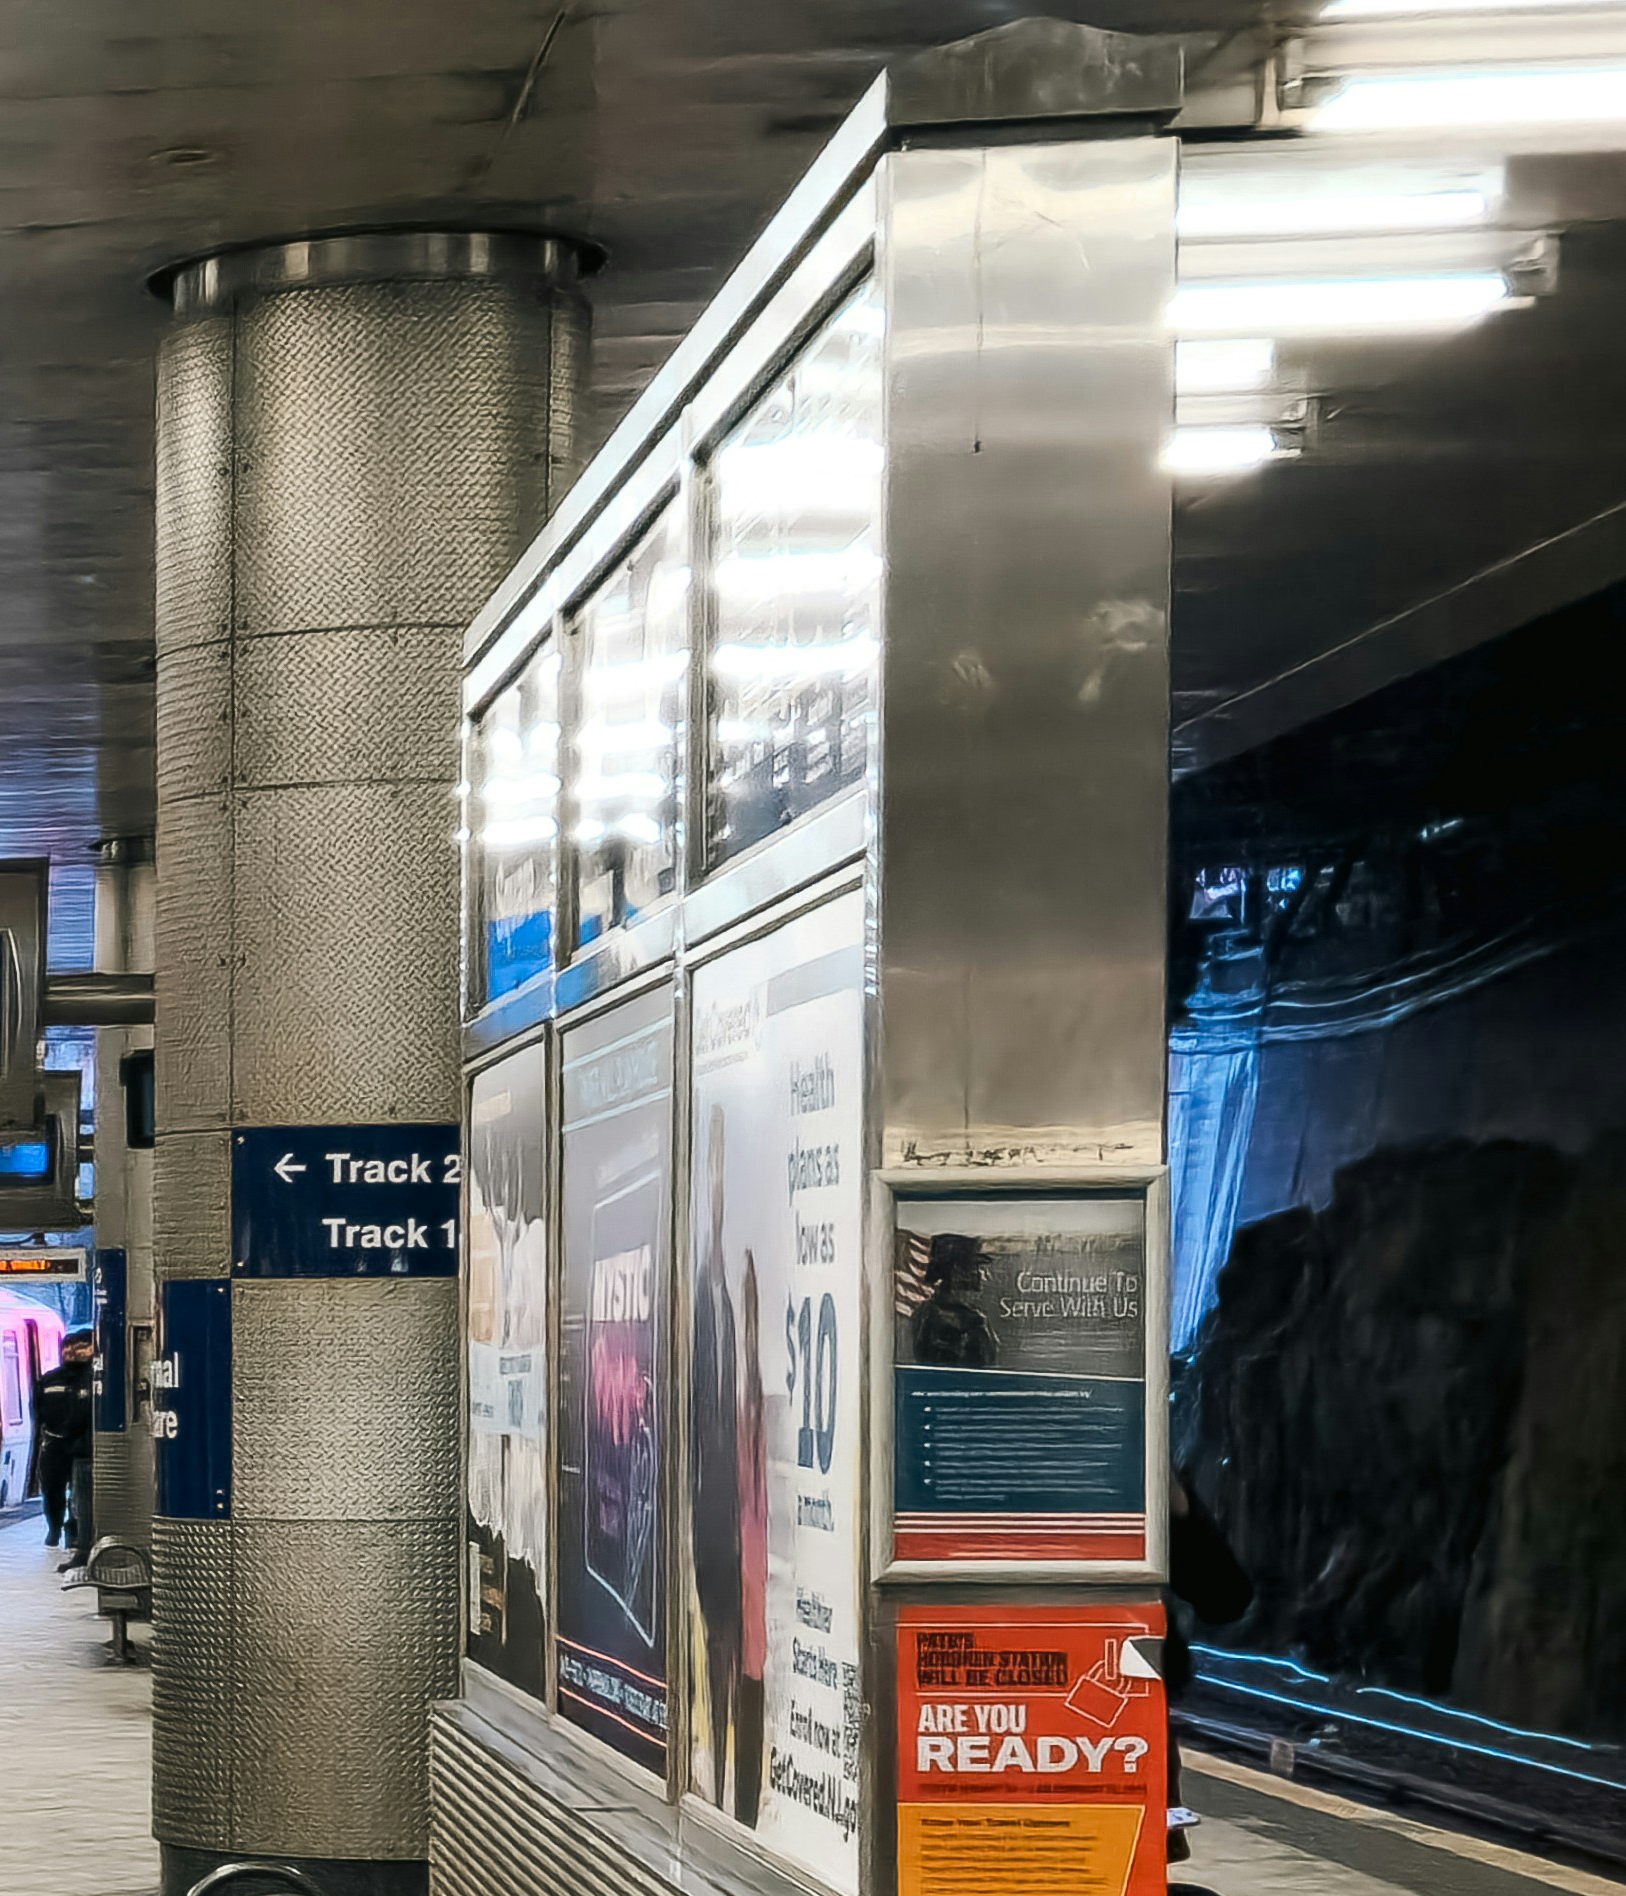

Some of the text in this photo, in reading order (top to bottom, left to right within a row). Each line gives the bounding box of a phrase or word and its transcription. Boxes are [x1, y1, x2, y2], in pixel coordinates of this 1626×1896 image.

[790, 1052, 835, 1116] Health
[325, 1152, 462, 1184] Track 2
[321, 1217, 456, 1249] Track 1
[1017, 1271, 1138, 1294] Continue To
[999, 1297, 1139, 1318] Serve With Us
[785, 1284, 838, 1475] $10
[918, 1703, 1027, 1734] ARE YOU
[917, 1736, 1149, 1773] READY?
